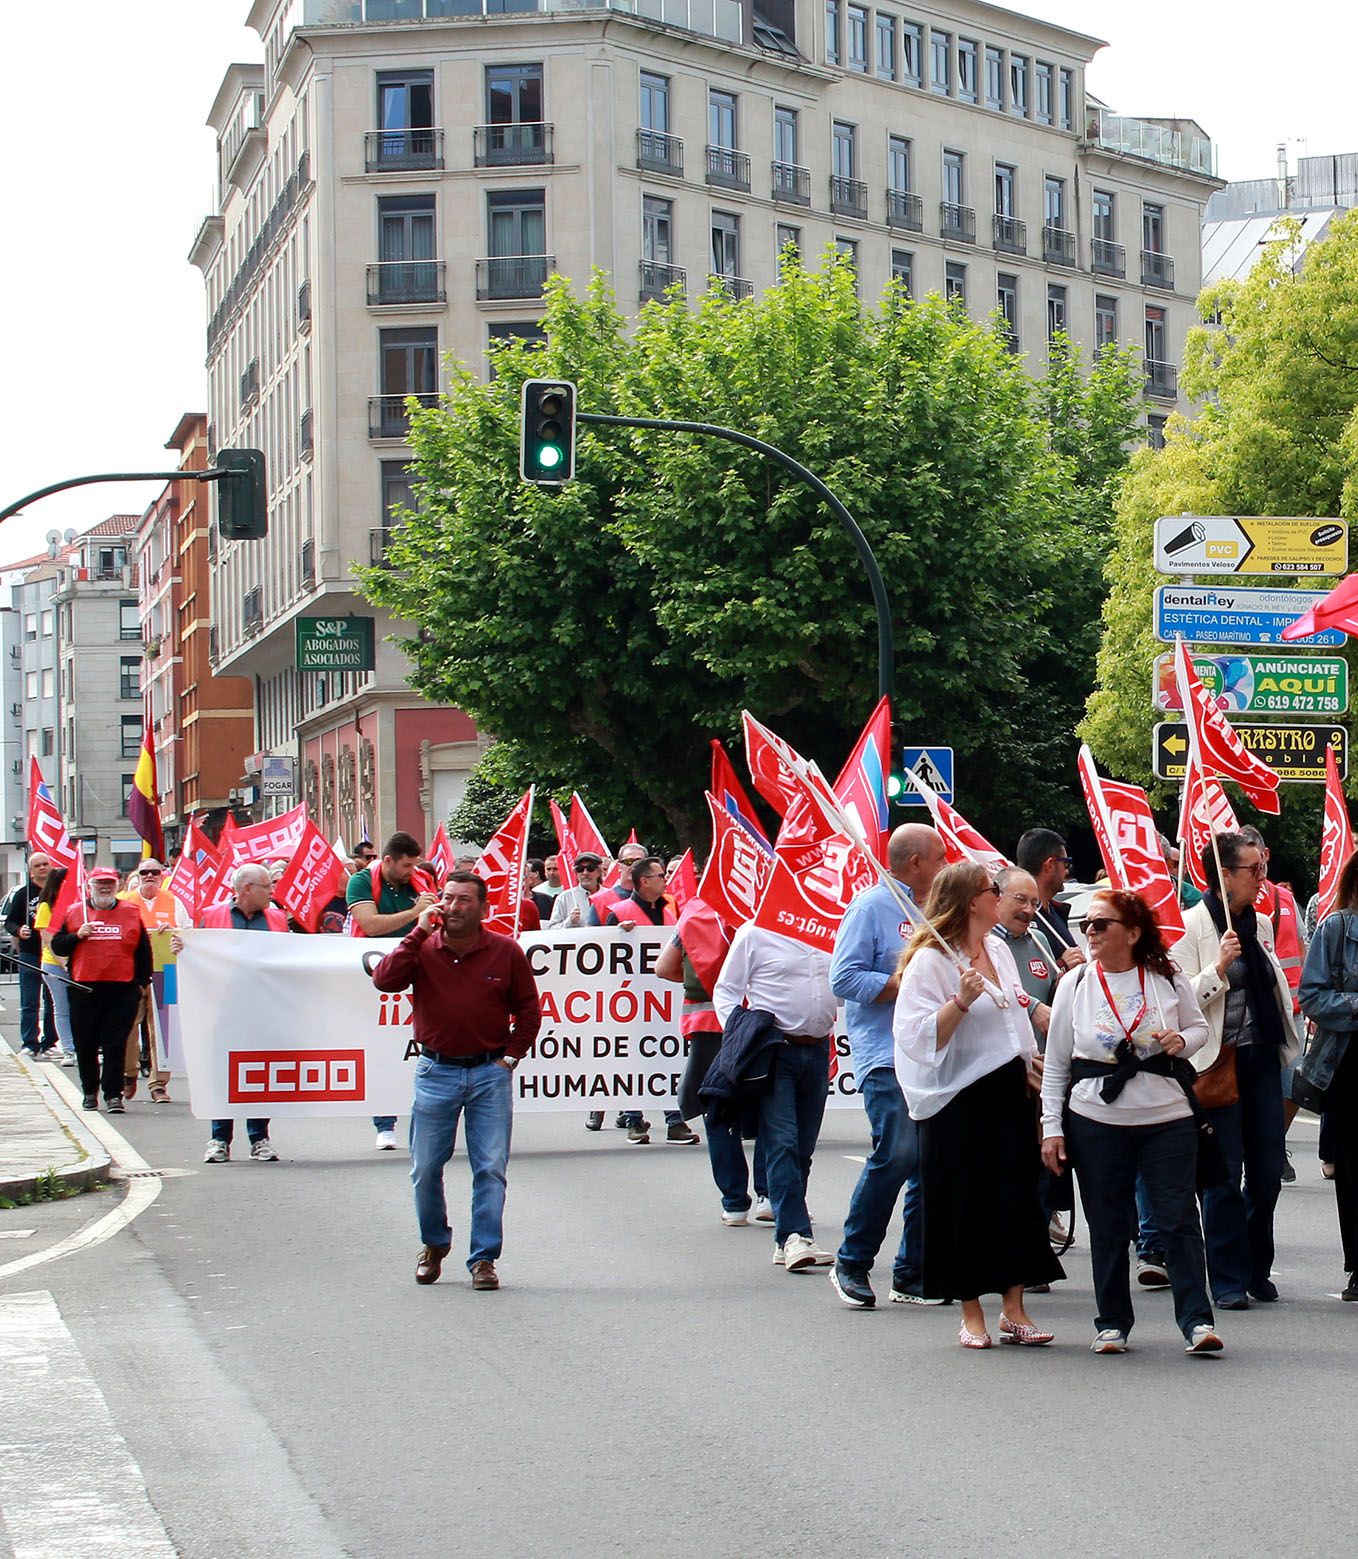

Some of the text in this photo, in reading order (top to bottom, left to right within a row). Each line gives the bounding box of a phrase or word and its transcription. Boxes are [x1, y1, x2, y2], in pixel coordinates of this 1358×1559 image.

[1209, 545, 1232, 554] PVC
[1164, 592, 1236, 609] dentalRey
[1259, 594, 1313, 604] odontólogos
[1164, 613, 1218, 625] ESTÉTICA
[1220, 616, 1263, 626] DENTAL
[315, 620, 348, 638] S&P
[1196, 631, 1218, 640] PASEO
[1219, 630, 1251, 642] MARÍTIMO
[1317, 635, 1335, 644] 261
[304, 639, 360, 651] ABOGADOS
[303, 653, 361, 665] ASOCIADOS
[1255, 661, 1340, 675] ANÚNCIATE
[1258, 676, 1337, 694] AQUÍ
[1268, 697, 1339, 710] 619 472 758
[1331, 731, 1342, 750] 2
[264, 781, 292, 789] FOGAR
[593, 1036, 629, 1058] DE
[238, 1060, 357, 1093] CCOO
